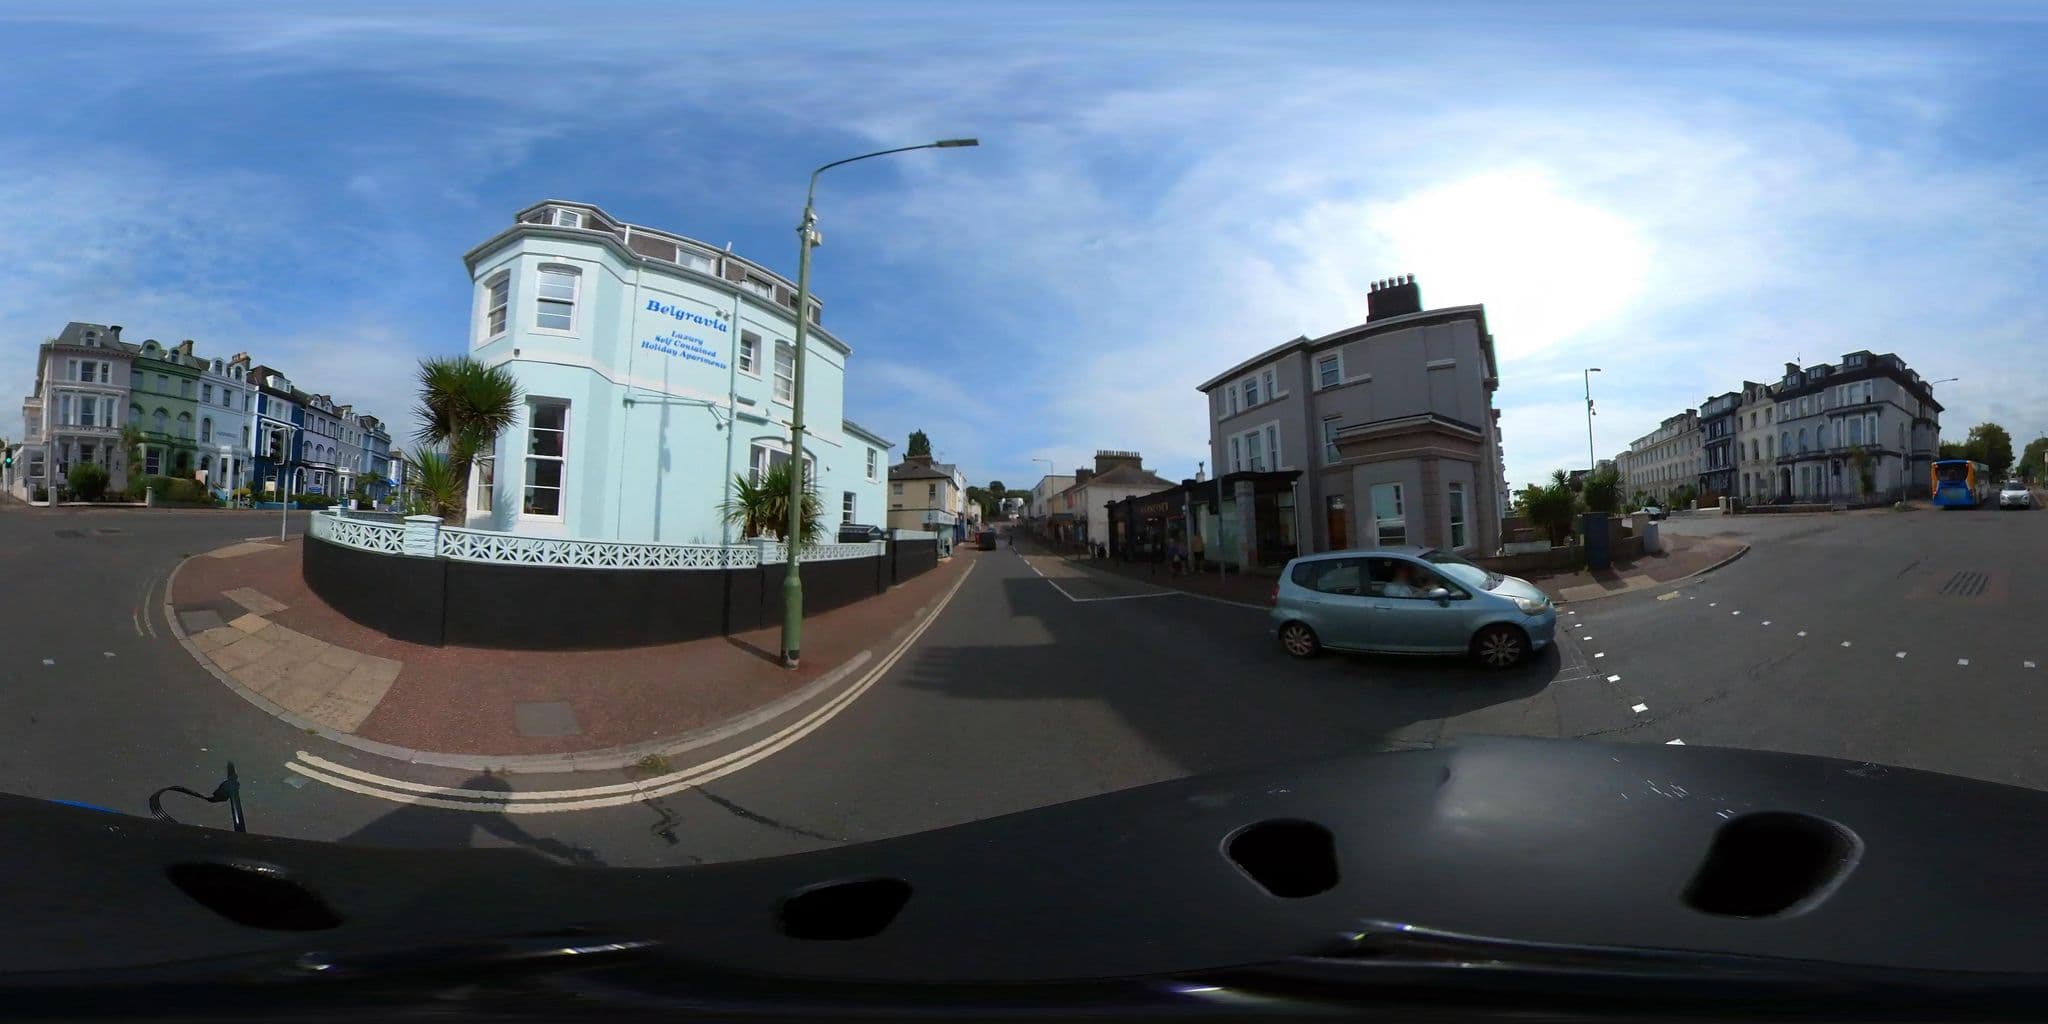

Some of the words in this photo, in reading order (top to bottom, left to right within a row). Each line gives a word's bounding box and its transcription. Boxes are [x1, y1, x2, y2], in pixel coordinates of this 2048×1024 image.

[646, 299, 727, 333] Belgravia
[655, 335, 673, 345] Self
[674, 340, 717, 357] Contained
[671, 330, 704, 345] Luxury
[641, 341, 678, 356] Holiday
[679, 350, 727, 369] Apartments
